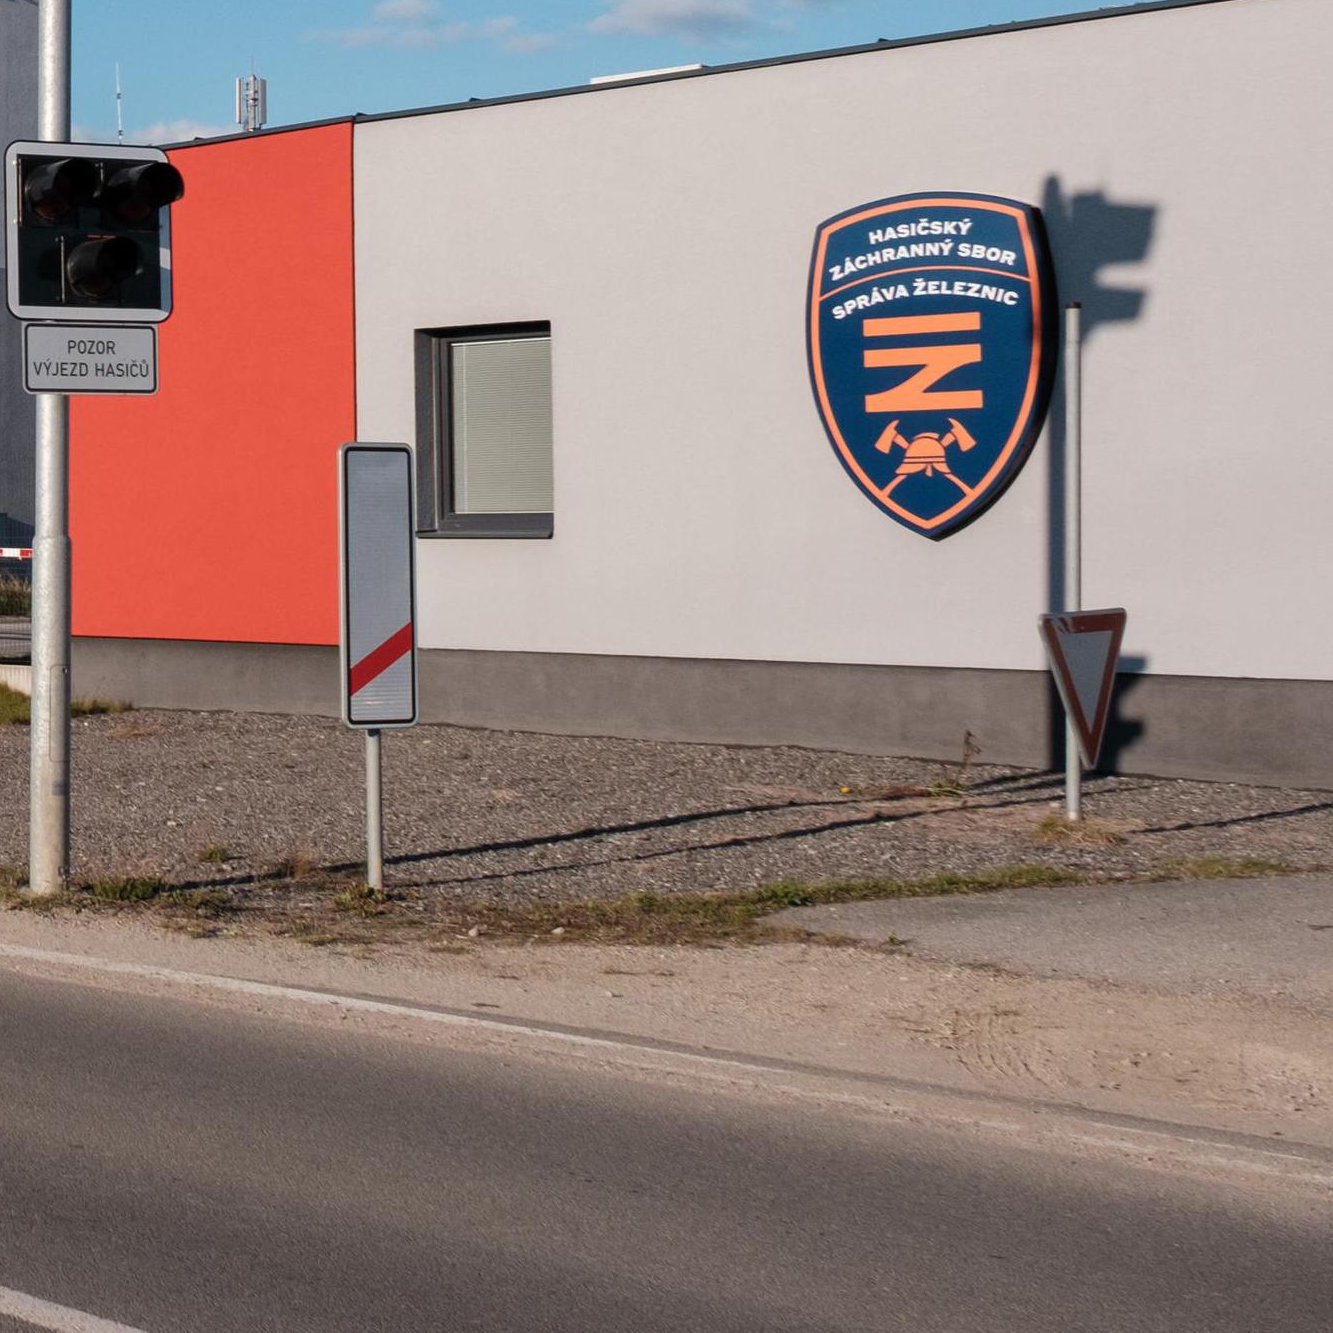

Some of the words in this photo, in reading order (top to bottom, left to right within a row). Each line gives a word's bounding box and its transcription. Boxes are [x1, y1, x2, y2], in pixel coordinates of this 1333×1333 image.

[868, 218, 973, 244] HASIČSKÝ
[828, 239, 954, 281] ZÁCHRANNÝ
[957, 243, 1017, 266] SBOR
[832, 284, 909, 319] SPRÁVA
[912, 278, 1019, 306] ŽELEZNIC
[67, 340, 116, 355] POZOR
[33, 358, 89, 377] VÝJEZD
[95, 359, 149, 378] HASIČŮ
